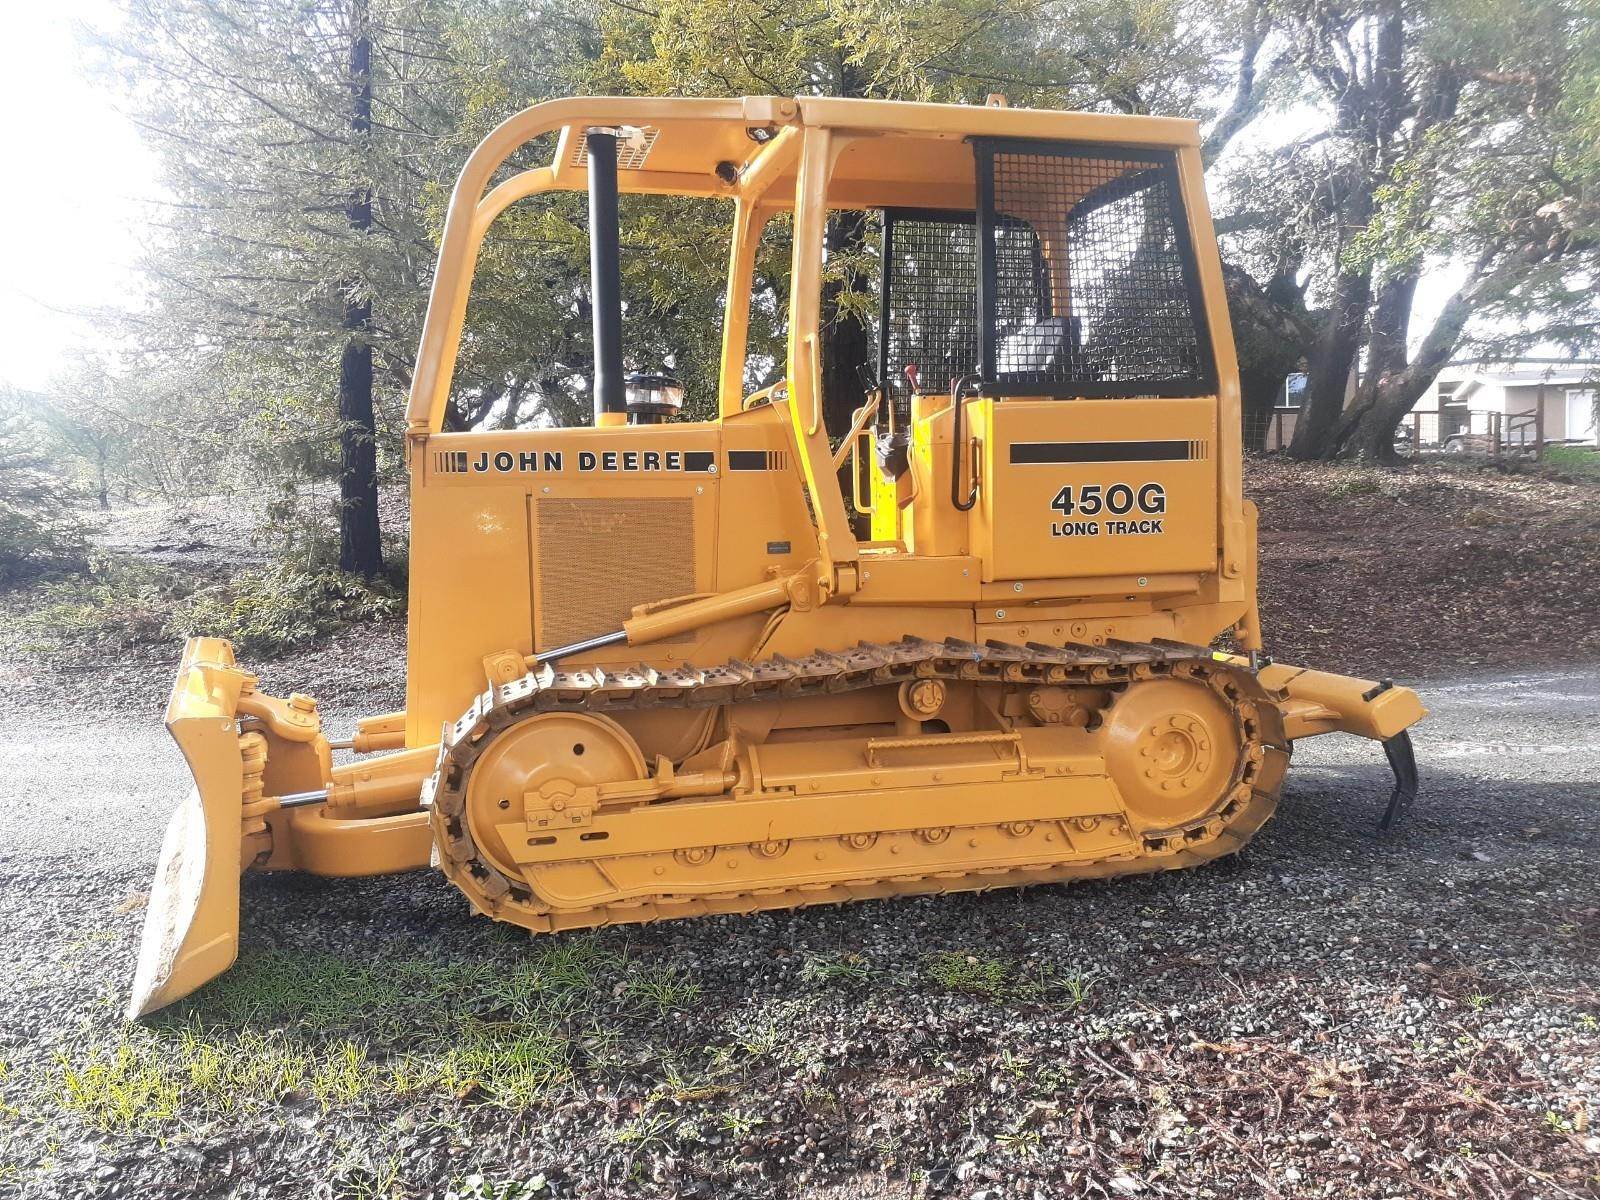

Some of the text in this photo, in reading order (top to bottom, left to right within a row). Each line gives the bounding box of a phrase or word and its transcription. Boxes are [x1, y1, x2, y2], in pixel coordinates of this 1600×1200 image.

[473, 450, 681, 472] JOHN DEERE
[1051, 482, 1166, 516] 450G
[1052, 520, 1163, 536] LONG TRACK
